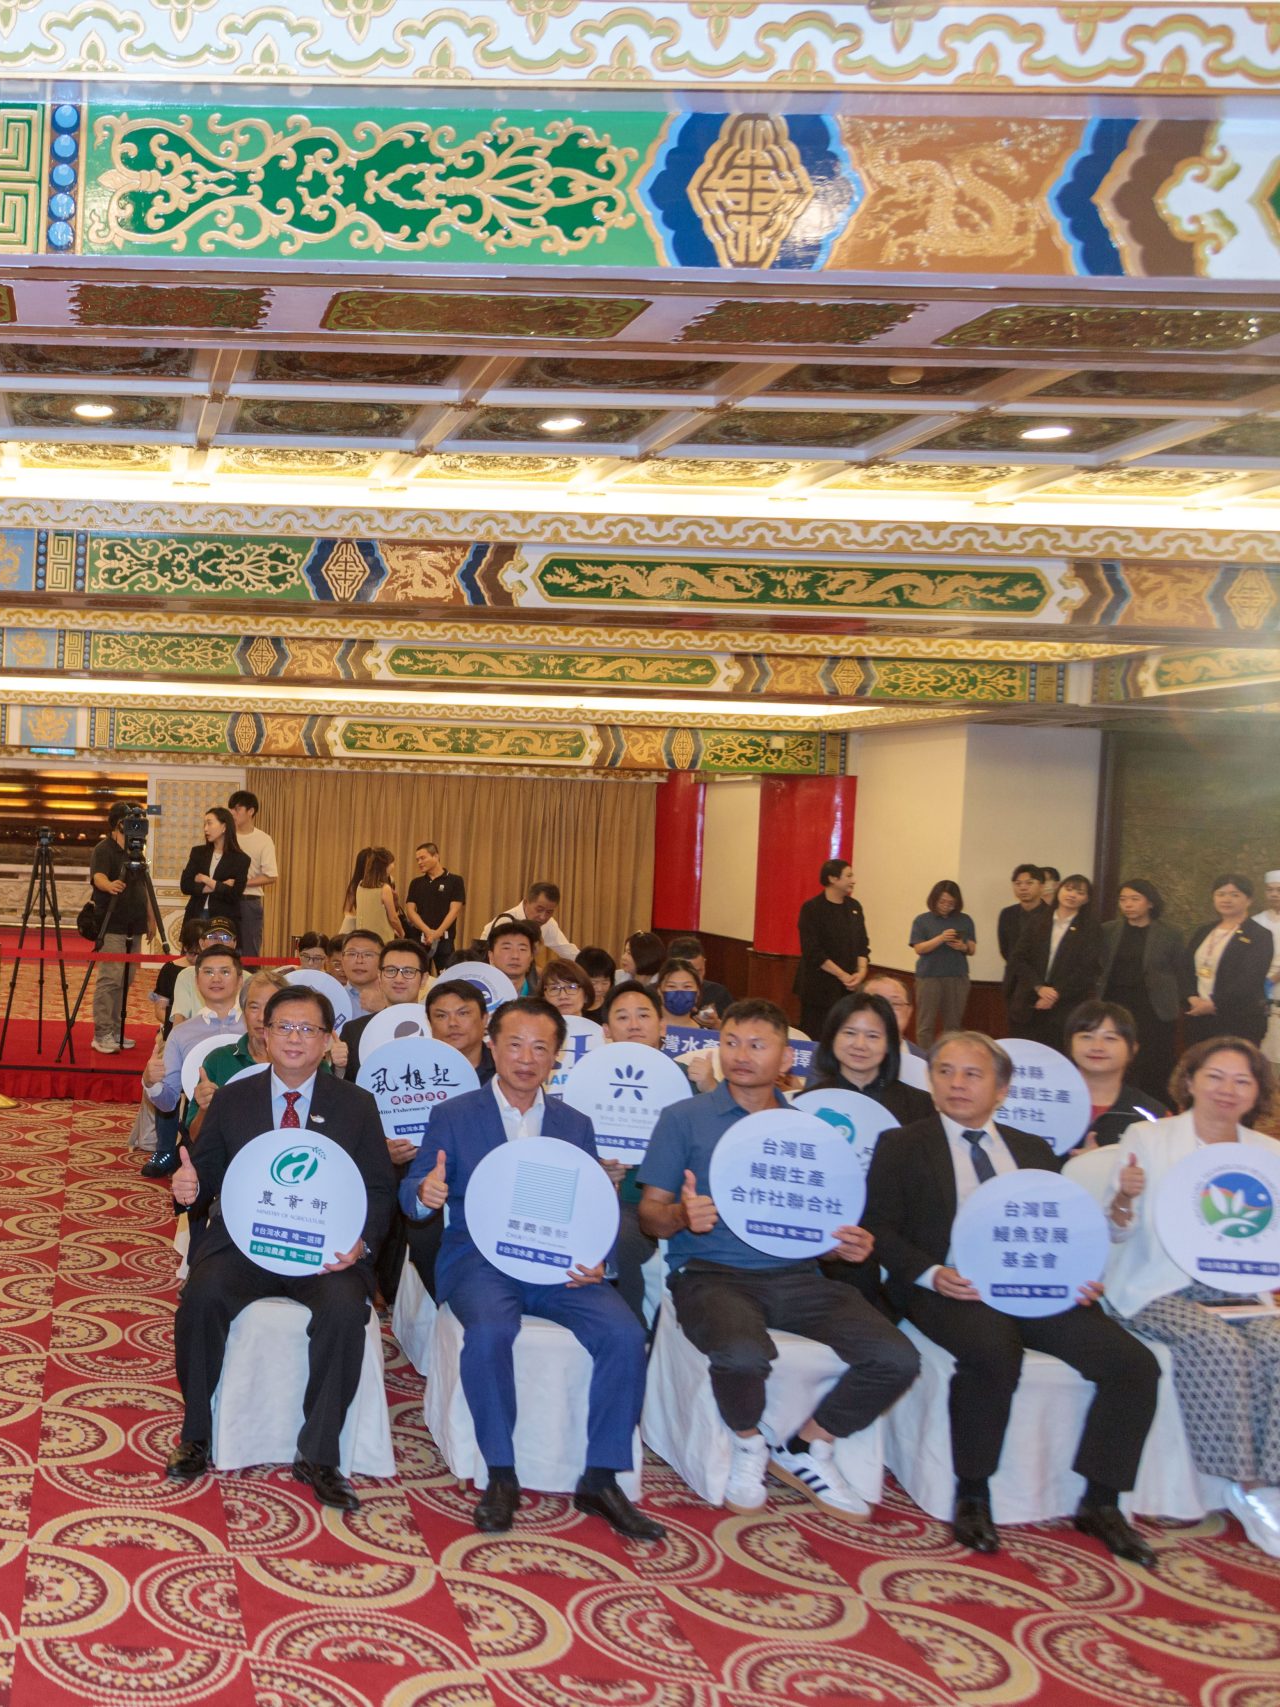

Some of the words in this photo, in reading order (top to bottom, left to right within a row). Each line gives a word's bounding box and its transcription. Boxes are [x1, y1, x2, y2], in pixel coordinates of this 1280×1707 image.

[996, 1105, 1046, 1122] 合作社
[762, 1138, 817, 1161] 台灣區
[750, 1162, 825, 1188] 鰻蝦生產
[258, 1190, 328, 1215] 農業部
[730, 1185, 844, 1216] 合作社聯合社
[1003, 1200, 1060, 1218] 台灣區
[992, 1226, 1069, 1244] 鰻魚發展
[1002, 1251, 1058, 1269] 基金會
